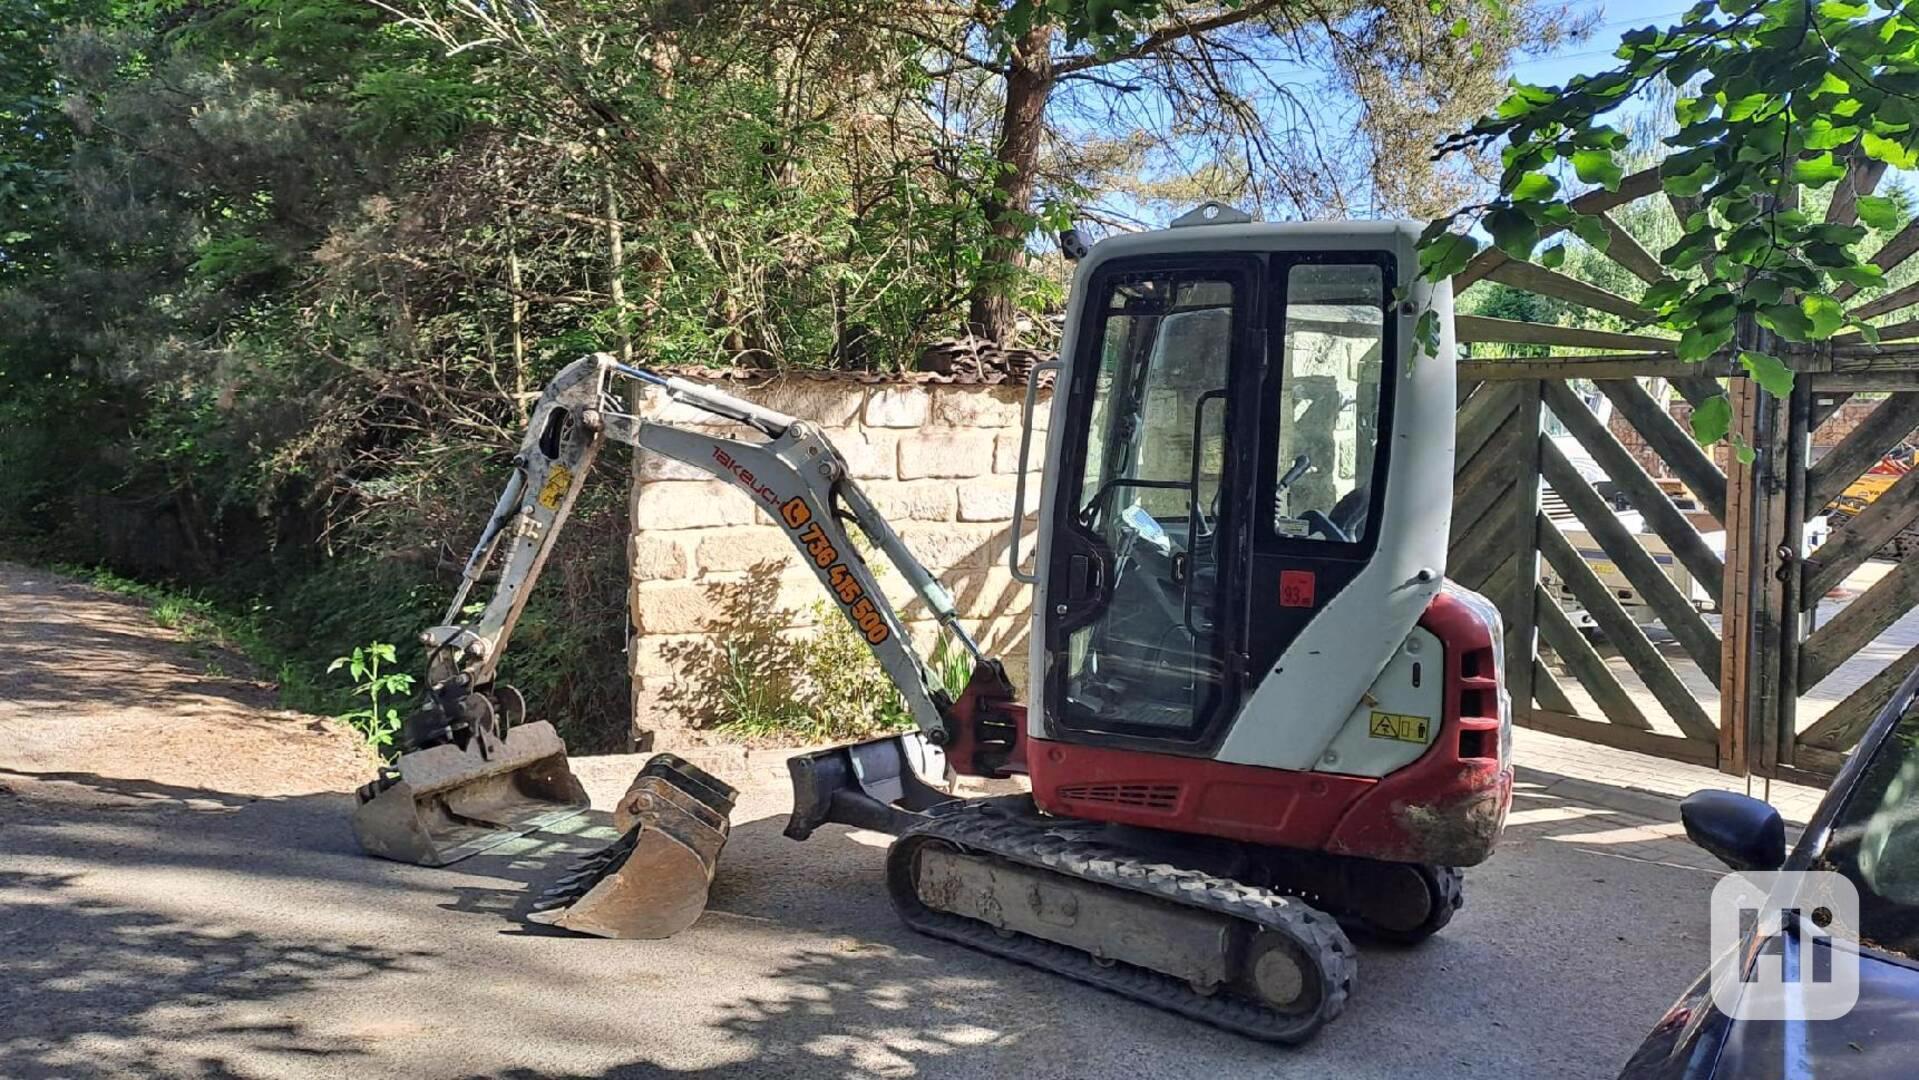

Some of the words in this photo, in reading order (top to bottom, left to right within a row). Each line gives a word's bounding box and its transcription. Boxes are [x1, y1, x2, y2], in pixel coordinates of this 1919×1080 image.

[799, 521, 838, 569] 736
[827, 564, 864, 605] 415
[849, 596, 890, 645] 500
